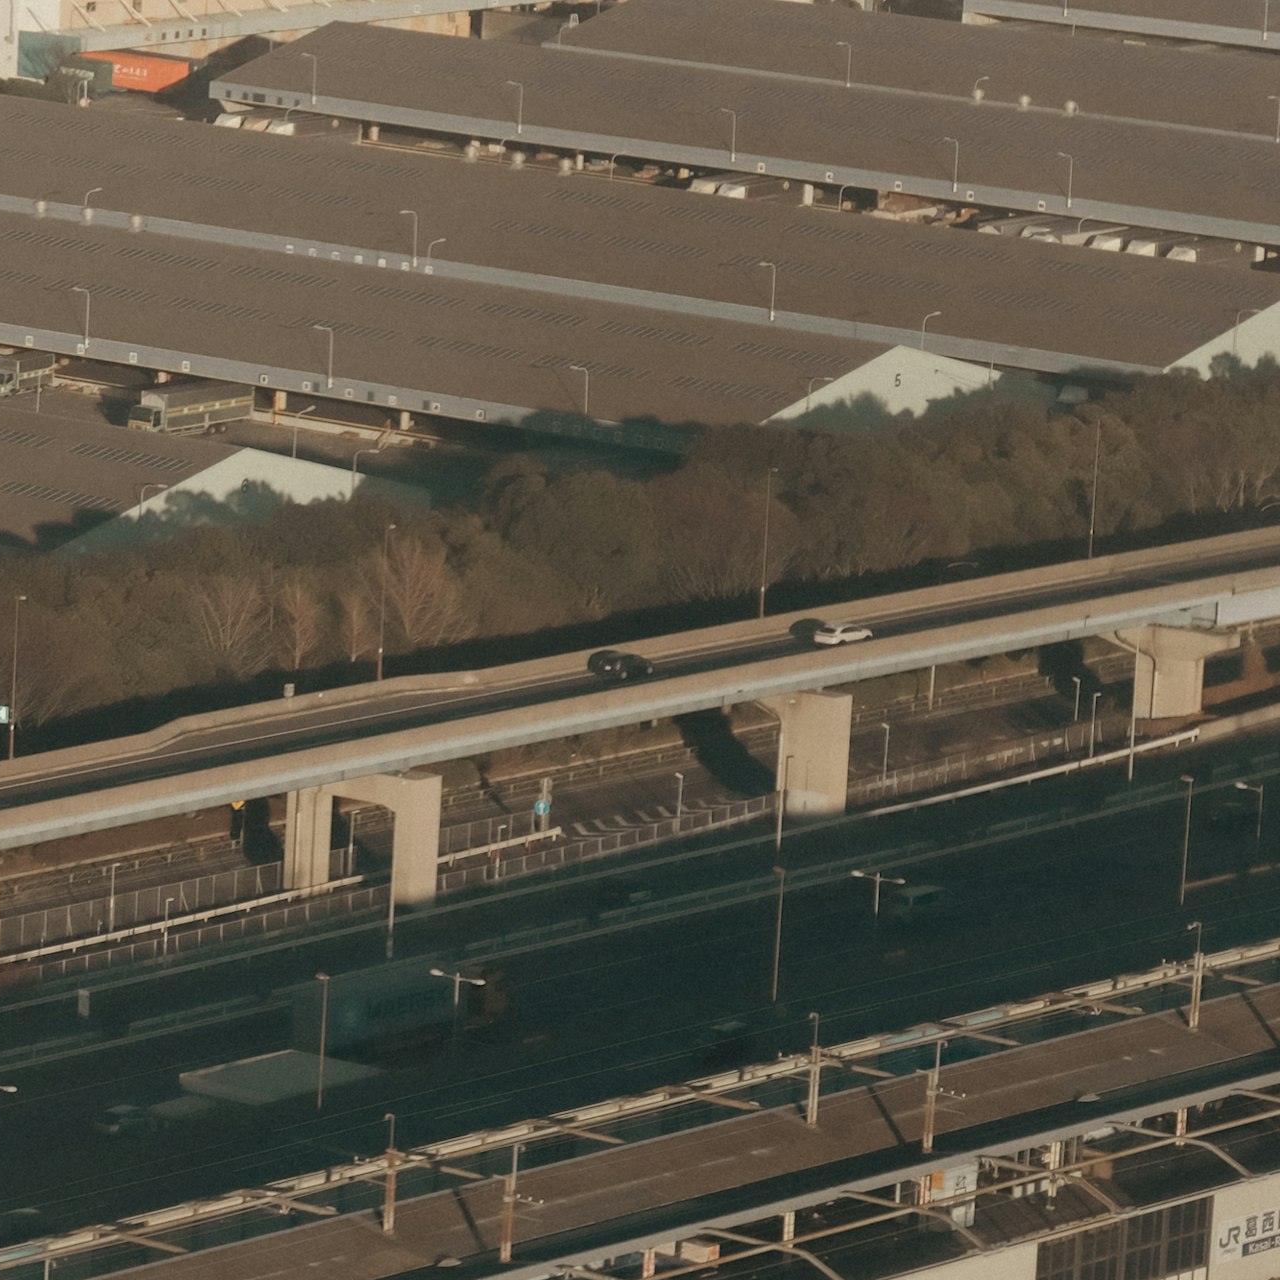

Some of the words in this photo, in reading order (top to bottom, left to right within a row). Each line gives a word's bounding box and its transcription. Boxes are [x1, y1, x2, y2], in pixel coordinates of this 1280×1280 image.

[894, 373, 901, 387] 5
[1245, 1209, 1280, 1239] 葛西
[1219, 1226, 1241, 1248] JR
